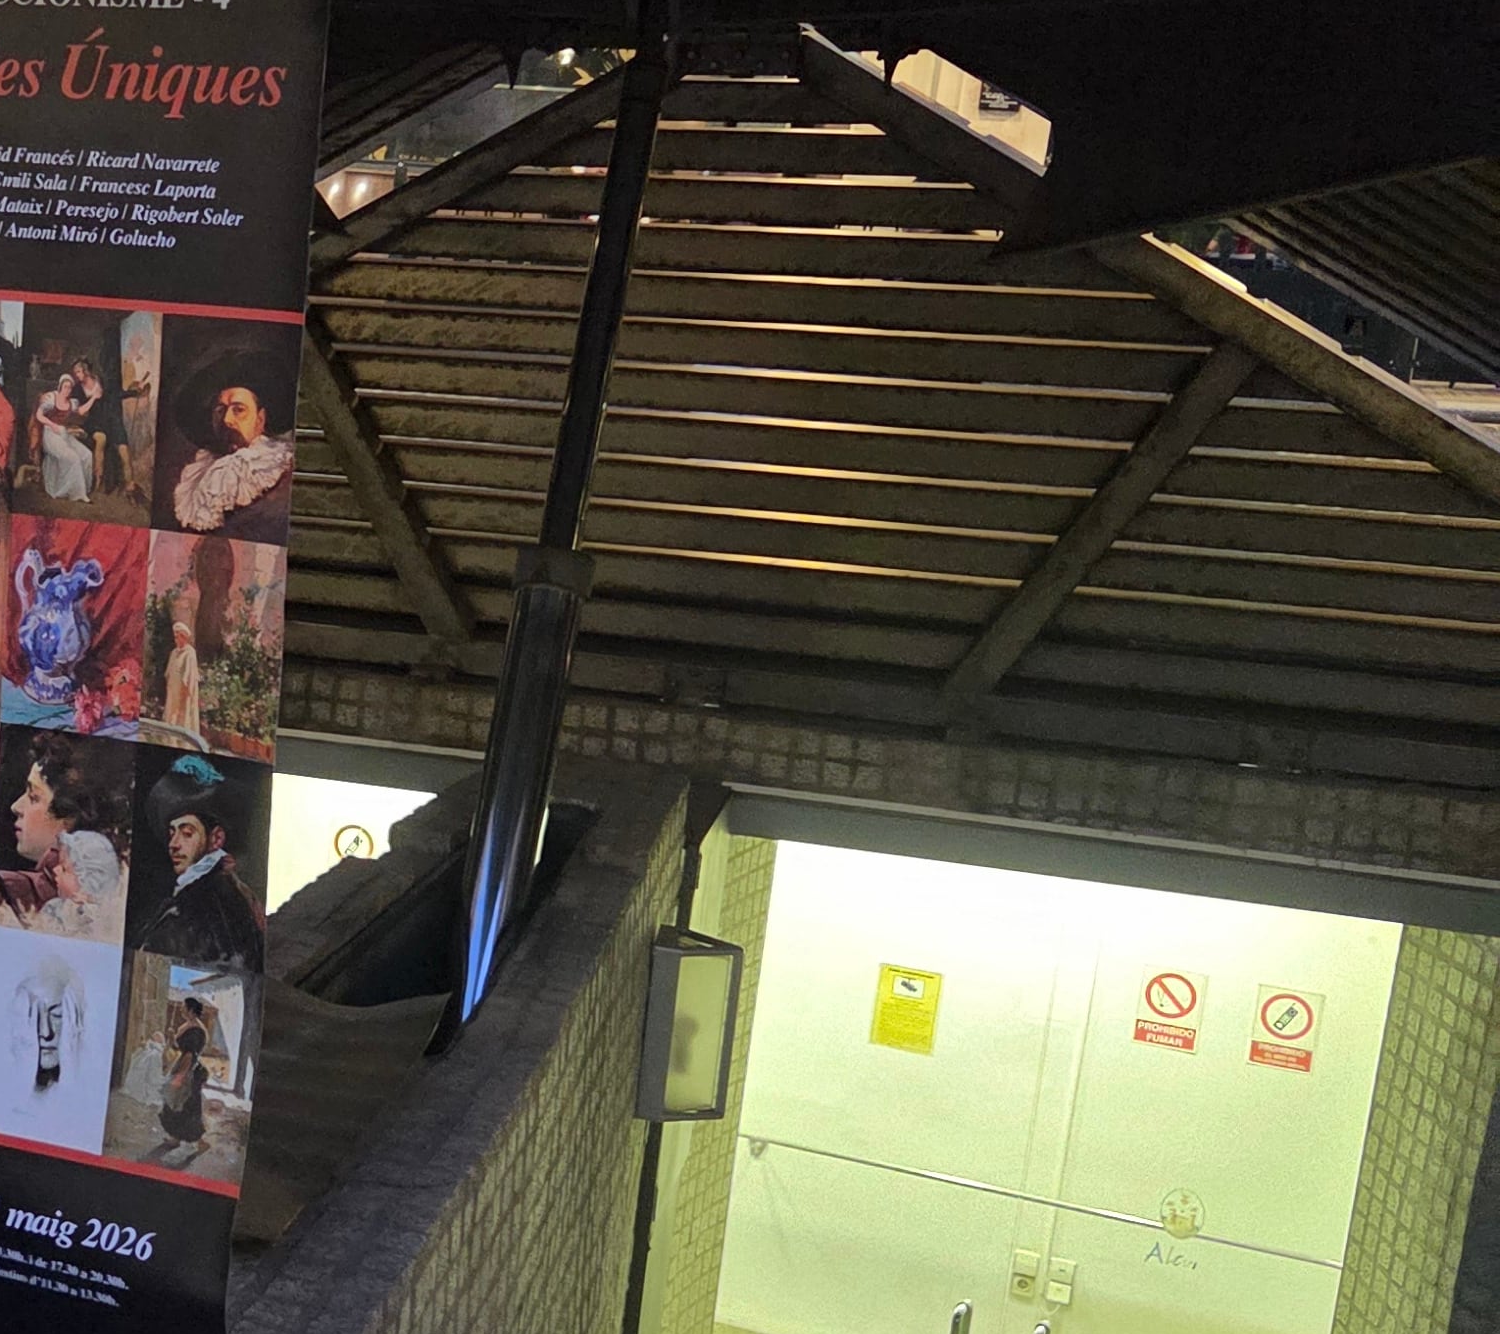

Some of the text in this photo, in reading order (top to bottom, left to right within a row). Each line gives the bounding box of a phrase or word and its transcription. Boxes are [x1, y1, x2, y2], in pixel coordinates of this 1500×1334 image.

[59, 27, 288, 120] Úniques
[13, 146, 75, 166] Francés
[86, 150, 140, 169] Ricard
[141, 153, 221, 173] Navarrete
[33, 173, 67, 191] Sala
[79, 175, 150, 196] Francesc
[153, 179, 217, 201] Laporta
[55, 199, 119, 222] Peresejo
[131, 203, 199, 226] Rigobert
[201, 206, 244, 227] Soler
[4, 222, 56, 241] Antoni
[59, 224, 98, 243] Miró
[109, 227, 177, 249] Golucho
[1138, 1022, 1194, 1038] PROHIBIDO
[1147, 1034, 1183, 1047] FUMAR
[5, 1209, 78, 1249] maig
[80, 1217, 157, 1262] 2026
